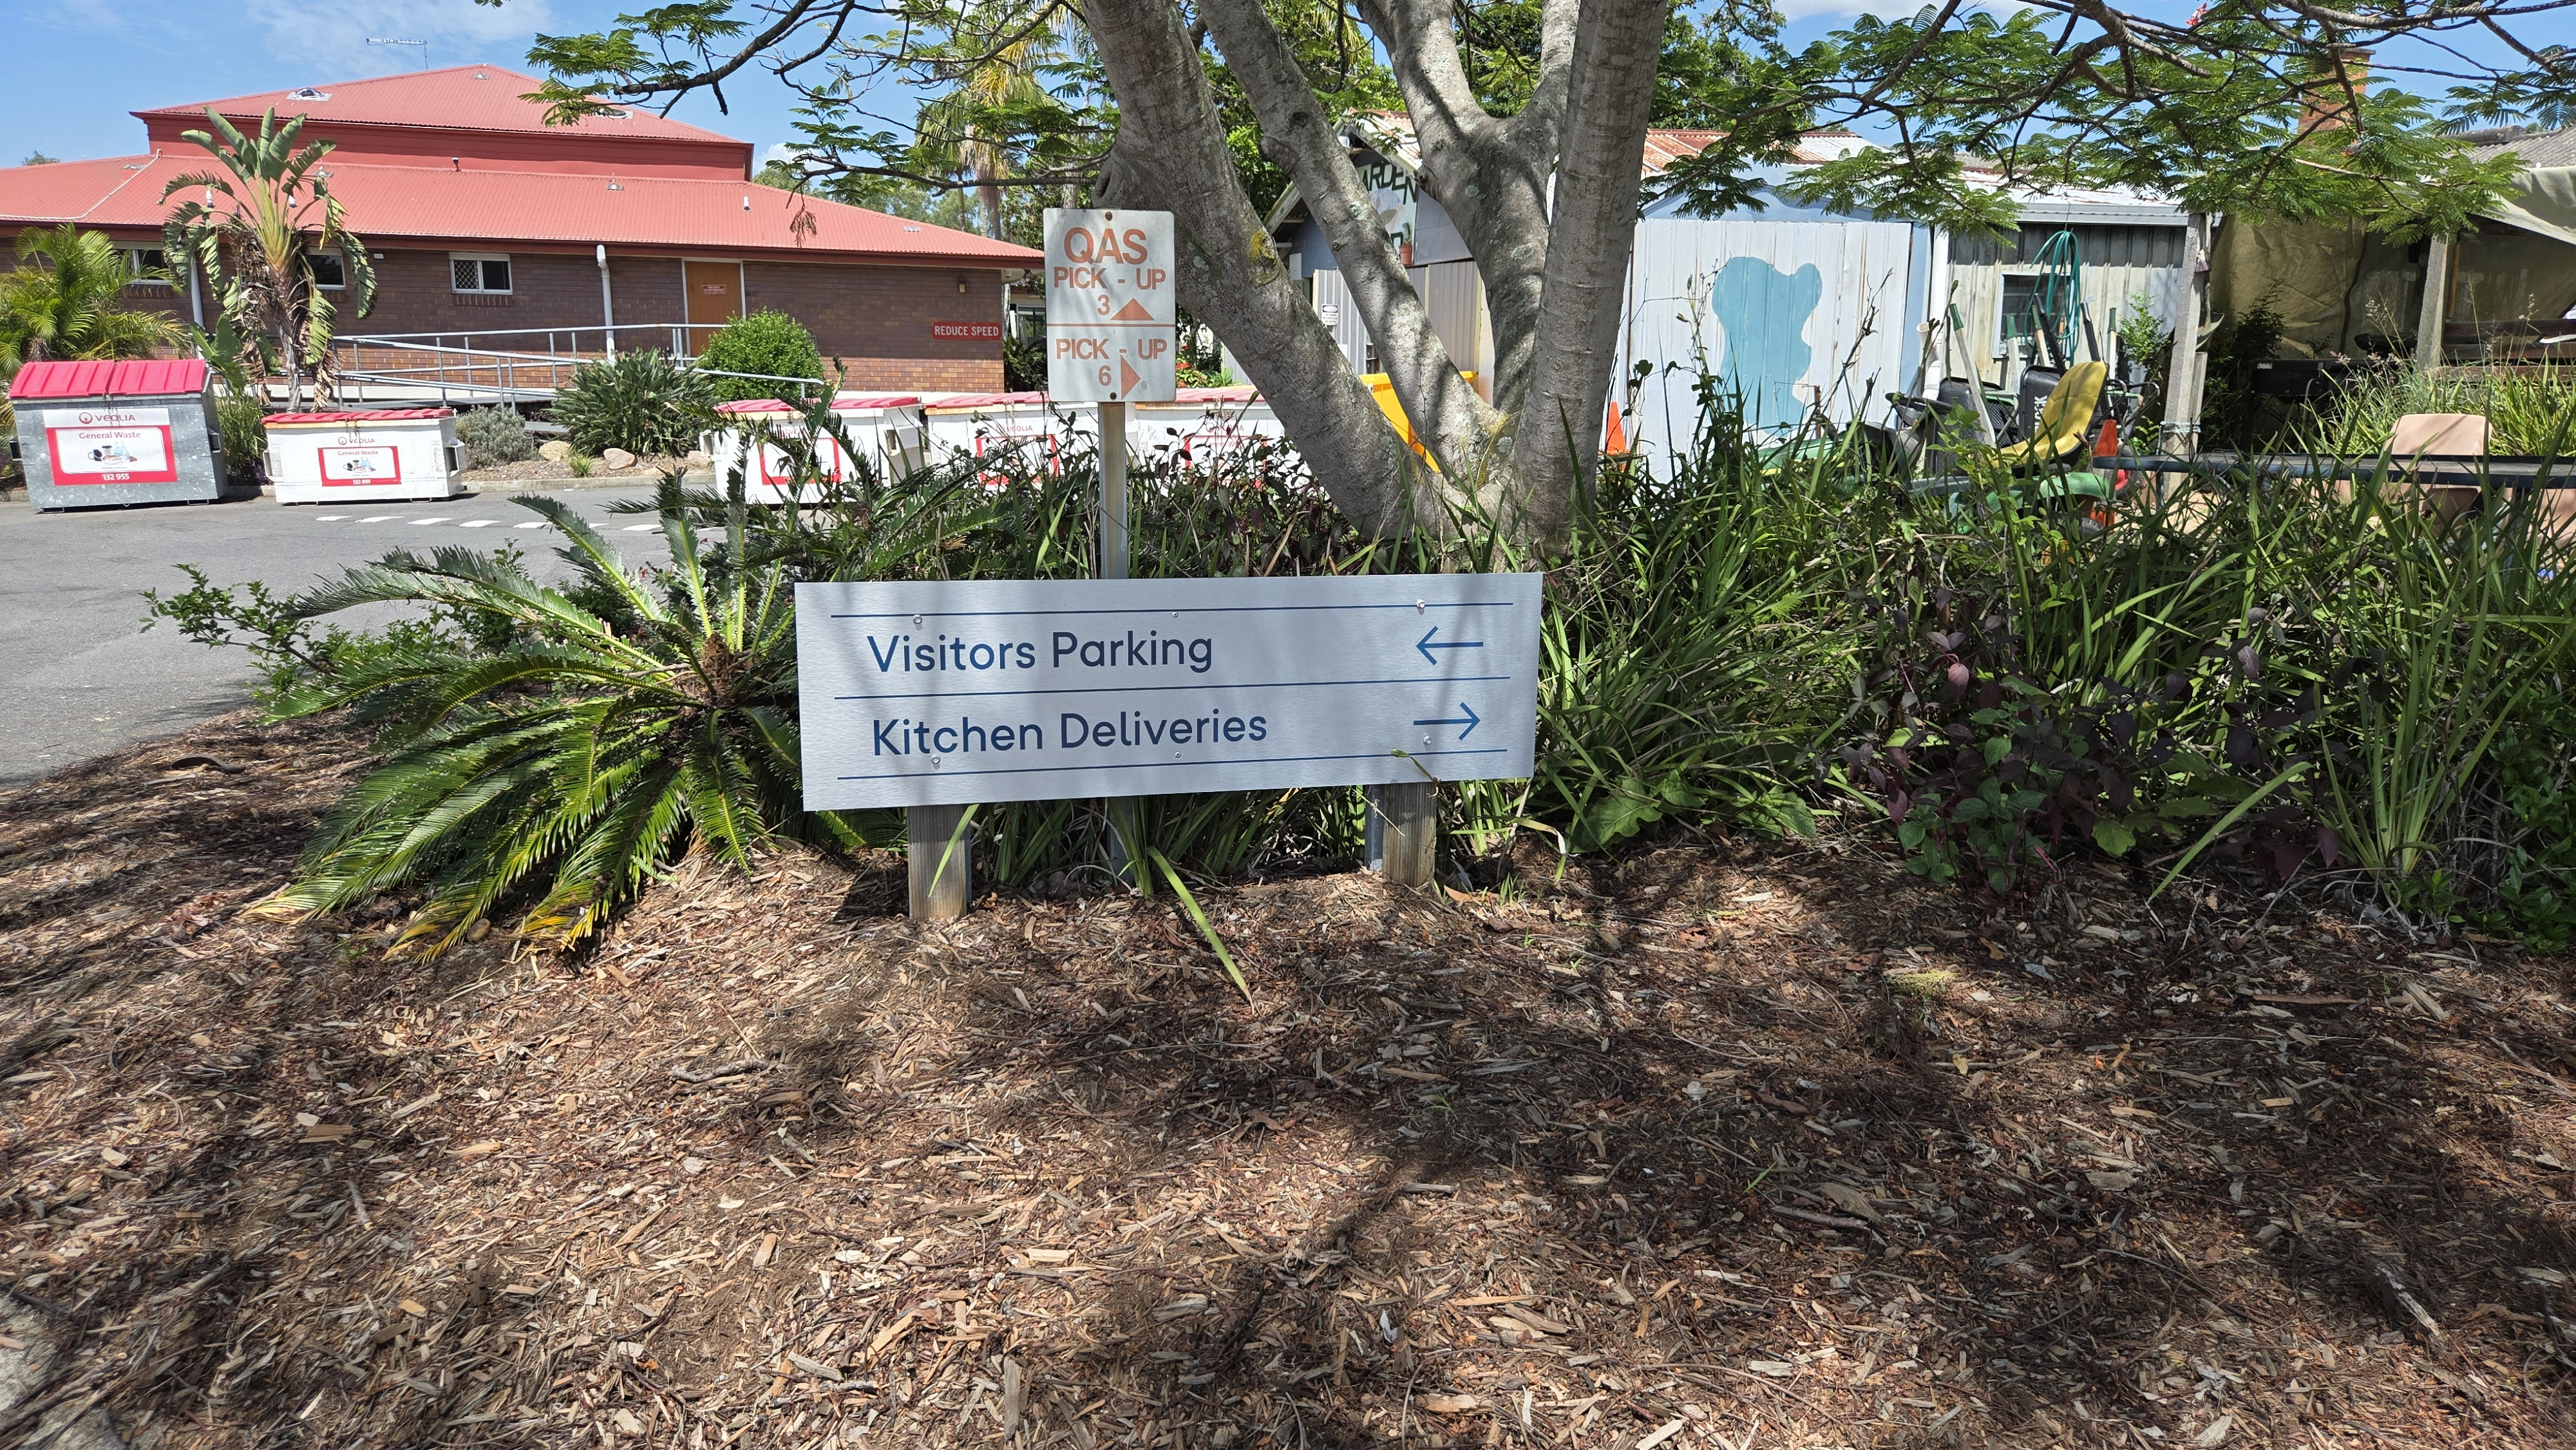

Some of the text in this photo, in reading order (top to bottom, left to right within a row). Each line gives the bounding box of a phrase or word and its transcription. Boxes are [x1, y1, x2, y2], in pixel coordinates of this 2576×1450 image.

[1361, 162, 1417, 205] ARDEN
[1064, 227, 1148, 265] QAS
[1054, 267, 1108, 289] PICK
[1136, 268, 1166, 290] UP
[1097, 294, 1110, 315] 3
[934, 326, 999, 336] REDUCE SPEED
[1056, 339, 1110, 359] PICK
[1138, 339, 1168, 359] UP
[1099, 365, 1112, 386] 6
[867, 630, 1212, 673] Visitors Parking
[873, 708, 1267, 756] Kitchen Deliveries
